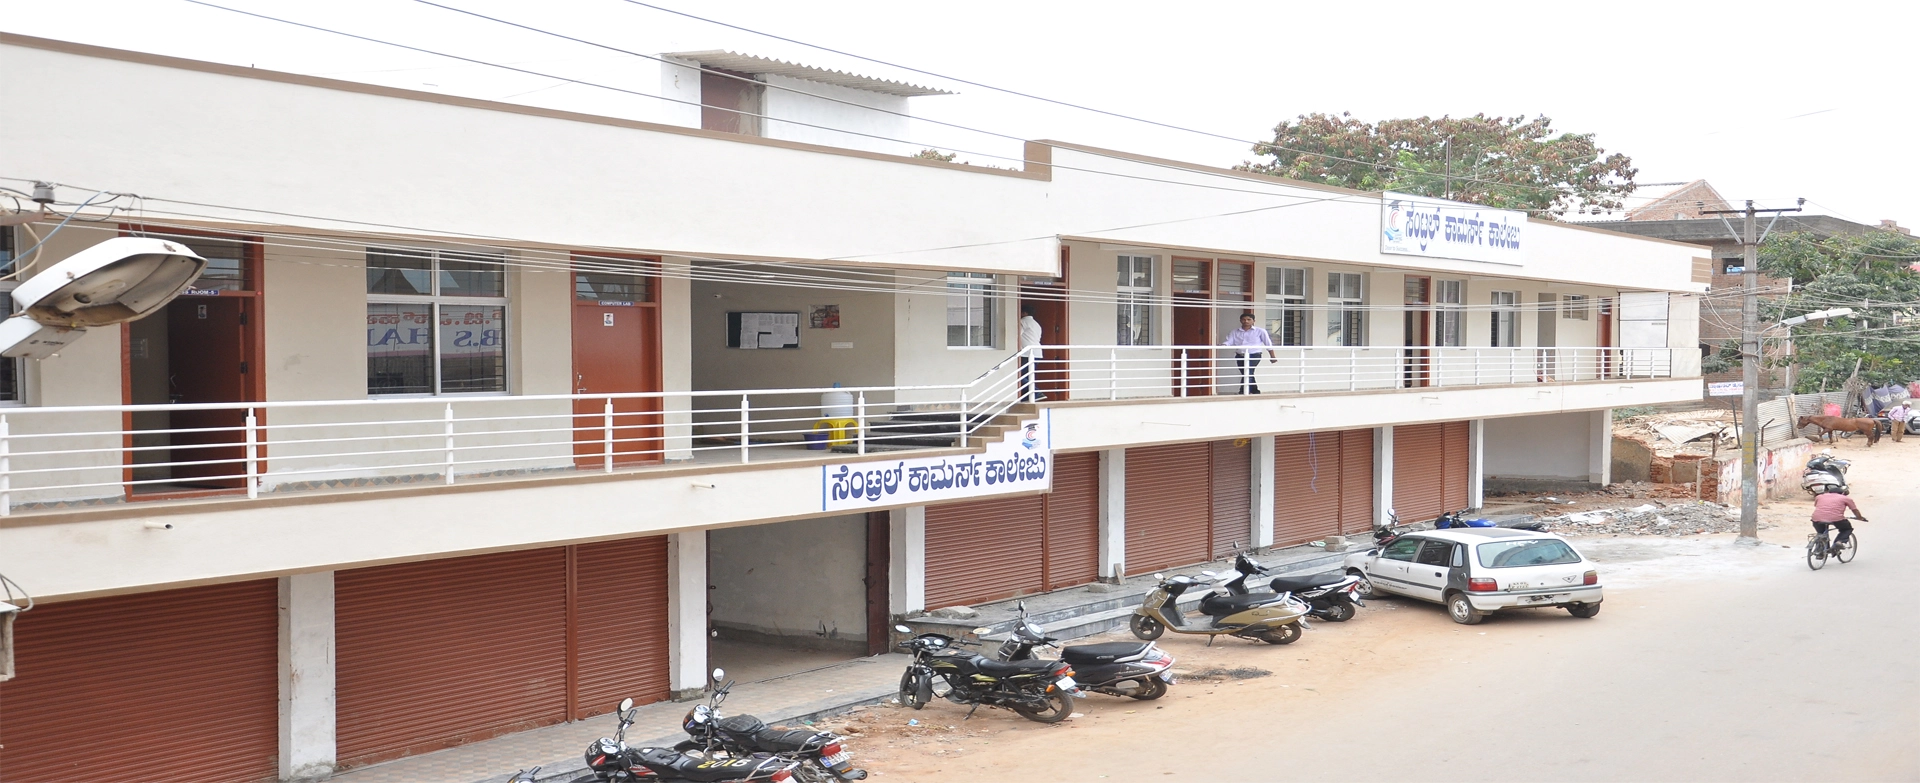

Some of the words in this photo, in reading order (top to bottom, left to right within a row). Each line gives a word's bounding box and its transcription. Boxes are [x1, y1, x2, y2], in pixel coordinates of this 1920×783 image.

[1489, 216, 1520, 249] ಕಾಲೇಜು
[832, 462, 904, 501] ಸೆಂಟ್ರಲ್
[908, 455, 982, 492] ಕಾಮರ್ಸ್
[985, 451, 1047, 486] ಕಾಲೇಜು
